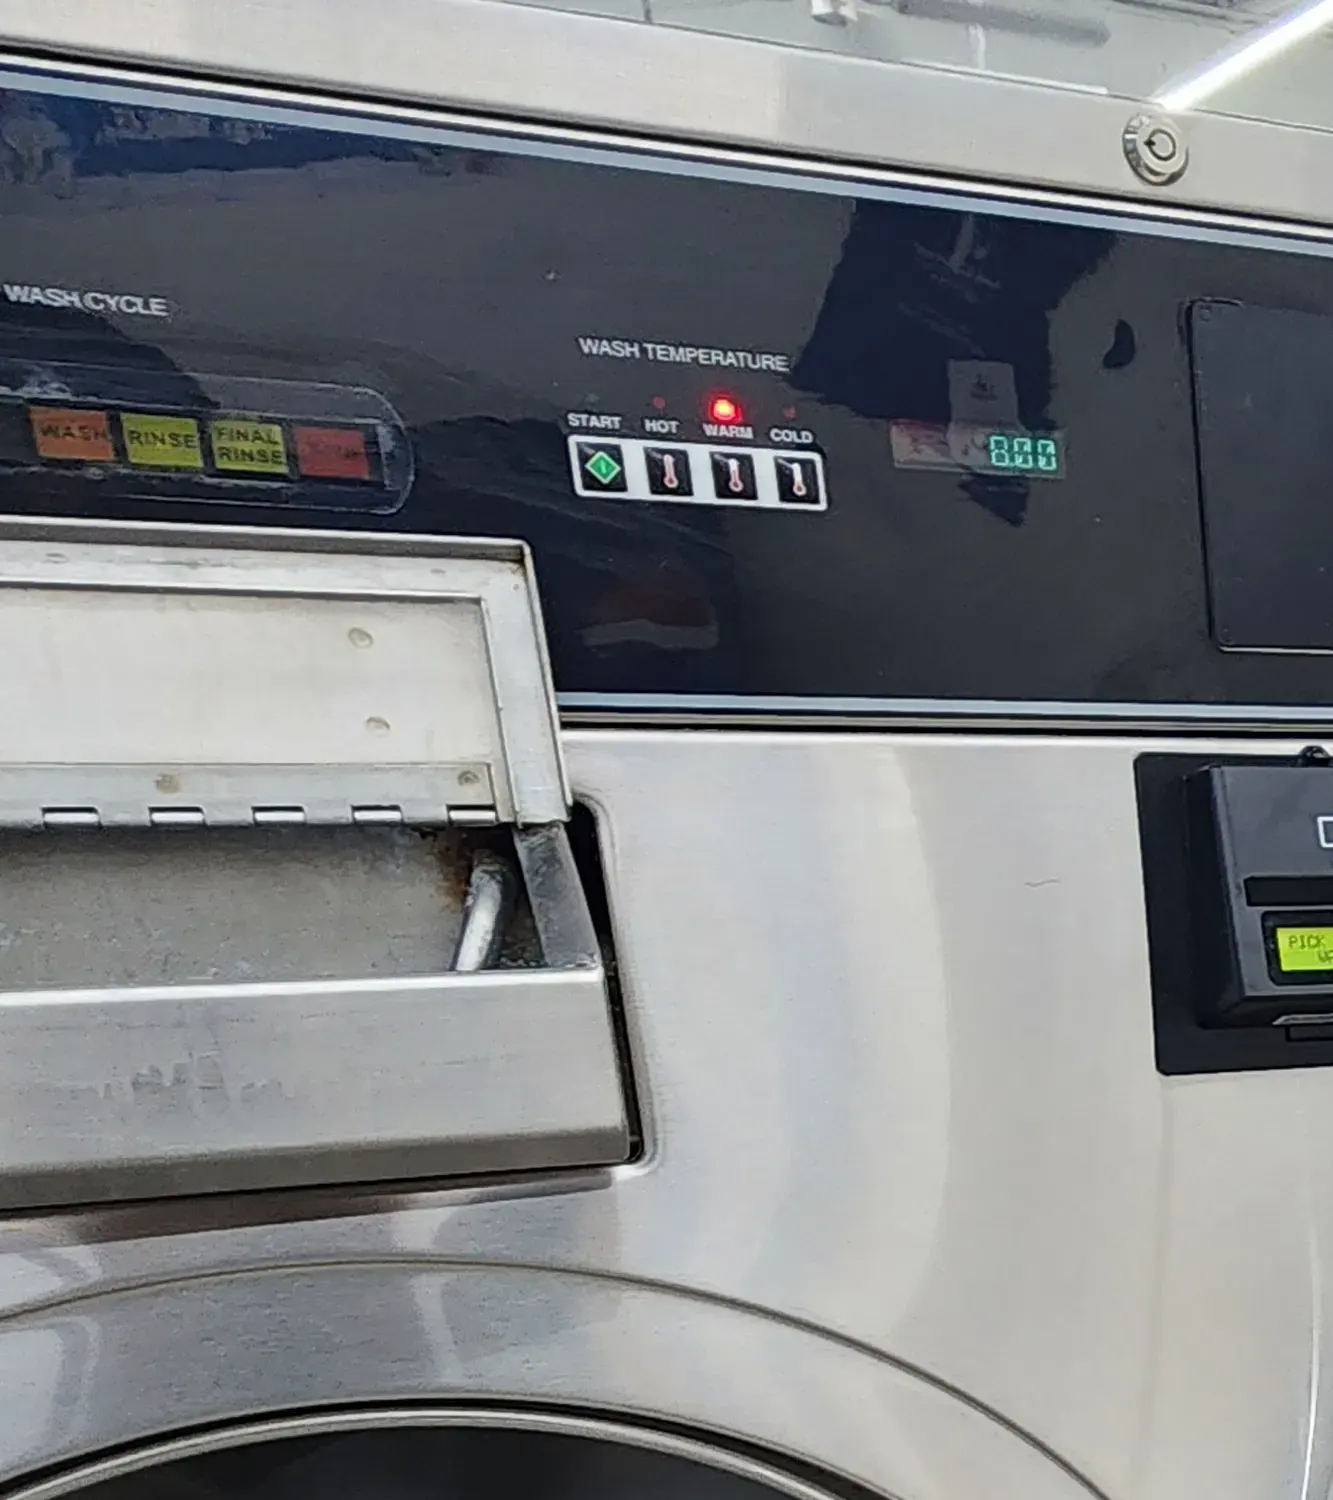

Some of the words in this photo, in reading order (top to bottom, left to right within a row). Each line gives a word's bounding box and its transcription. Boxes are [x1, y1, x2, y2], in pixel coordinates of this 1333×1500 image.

[3, 283, 83, 310] WASH
[84, 291, 169, 317] CYCLE
[577, 337, 640, 360] WASH
[642, 342, 790, 372] TEMPERATURE
[216, 425, 280, 445] FINAL
[567, 413, 622, 429] START
[644, 418, 680, 434] HOT
[703, 423, 754, 440] WARM
[769, 428, 814, 445] COLD
[128, 430, 197, 449] RINSE
[217, 444, 286, 464] RINSE
[1288, 934, 1325, 949] PICK
